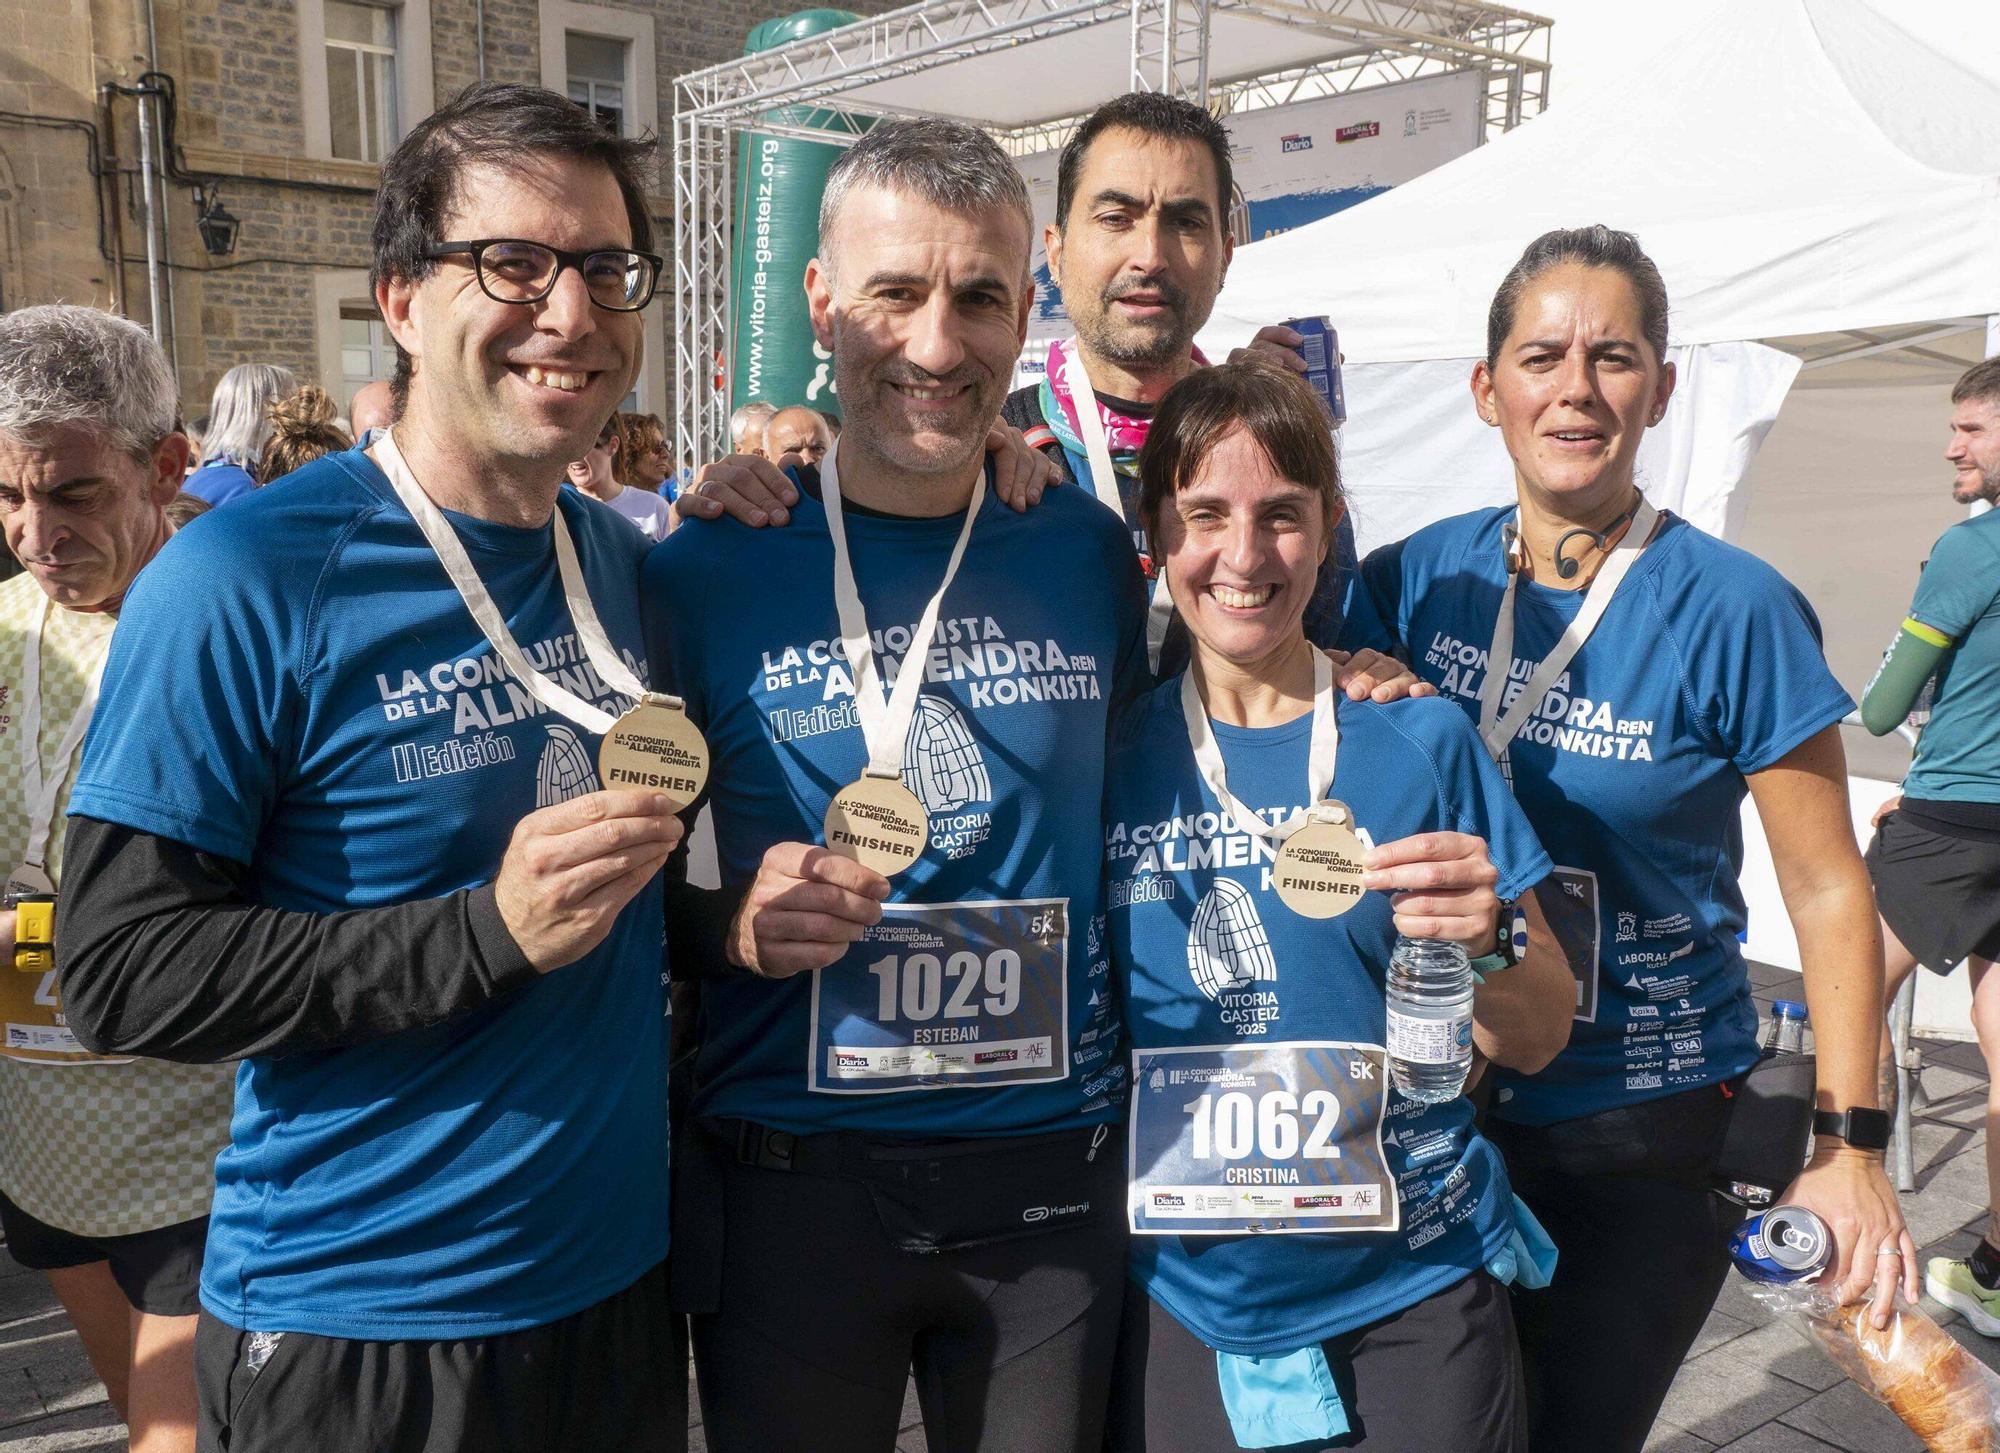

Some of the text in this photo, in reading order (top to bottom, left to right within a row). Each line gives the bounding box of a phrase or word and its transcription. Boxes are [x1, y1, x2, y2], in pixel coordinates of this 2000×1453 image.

[1284, 139, 1310, 152] Diario
[748, 139, 779, 397] www.vitoria-gasteiz.org
[1431, 631, 1451, 655] LA
[761, 645, 804, 676] LA
[765, 673, 793, 693] DE
[796, 668, 823, 687] LA
[1071, 655, 1097, 673] REN
[376, 670, 426, 701] LA
[968, 675, 1102, 710] KONKISTA
[1424, 651, 1438, 666] DE
[1438, 656, 1450, 671] LA
[1615, 719, 1653, 736] REN
[384, 699, 417, 722] DE
[420, 694, 452, 715] LA
[769, 699, 863, 744] II Edició
[615, 733, 675, 748] LA CONQUISTA
[1517, 717, 1653, 762] KONKISTA
[391, 731, 516, 784] II Edición
[629, 742, 689, 759] ALMENDRA
[660, 756, 701, 769] KONKISTA
[609, 768, 697, 793] FINISHER
[850, 801, 896, 816] CONQUISTA
[851, 808, 909, 828] ALMENDRA
[929, 812, 992, 832] VITORIA
[880, 822, 920, 837] KONKISTA
[832, 830, 915, 858] FINISHER
[931, 829, 990, 850] GASTEIZ
[947, 846, 976, 861] 2025
[1118, 844, 1138, 858] LA
[1297, 848, 1340, 858] CONQUISTA
[1298, 855, 1352, 867] ALMENDRA
[1327, 865, 1364, 874] KONKISTA
[1282, 878, 1360, 895] FINISHER
[1562, 882, 1584, 898] 5K
[876, 926, 920, 934] CONQUISTA
[1031, 914, 1054, 934] 5K
[878, 933, 933, 942] ALMENDRA
[1618, 952, 1668, 965] LABORAL
[868, 948, 1021, 1022] 1029
[1218, 991, 1279, 1008] VITORIA
[1220, 1006, 1280, 1023] GASTEIZ
[1632, 1006, 1656, 1015] Kaiku
[913, 1025, 979, 1044] ESTEBAN
[1235, 1022, 1267, 1035] 2025
[839, 1057, 866, 1066] Diario
[1190, 1067, 1232, 1076] CONQUISTA
[1193, 1073, 1245, 1083] ALMENDRA
[1350, 1061, 1375, 1081] 5K
[1626, 1075, 1663, 1089] FORONDA
[1383, 1099, 1425, 1119] ABORAL
[1183, 1090, 1341, 1160] 1062
[1226, 1167, 1300, 1184] CRISTINA
[1405, 1180, 1428, 1193] GRUPO
[1050, 1201, 1090, 1216] Kalenji
